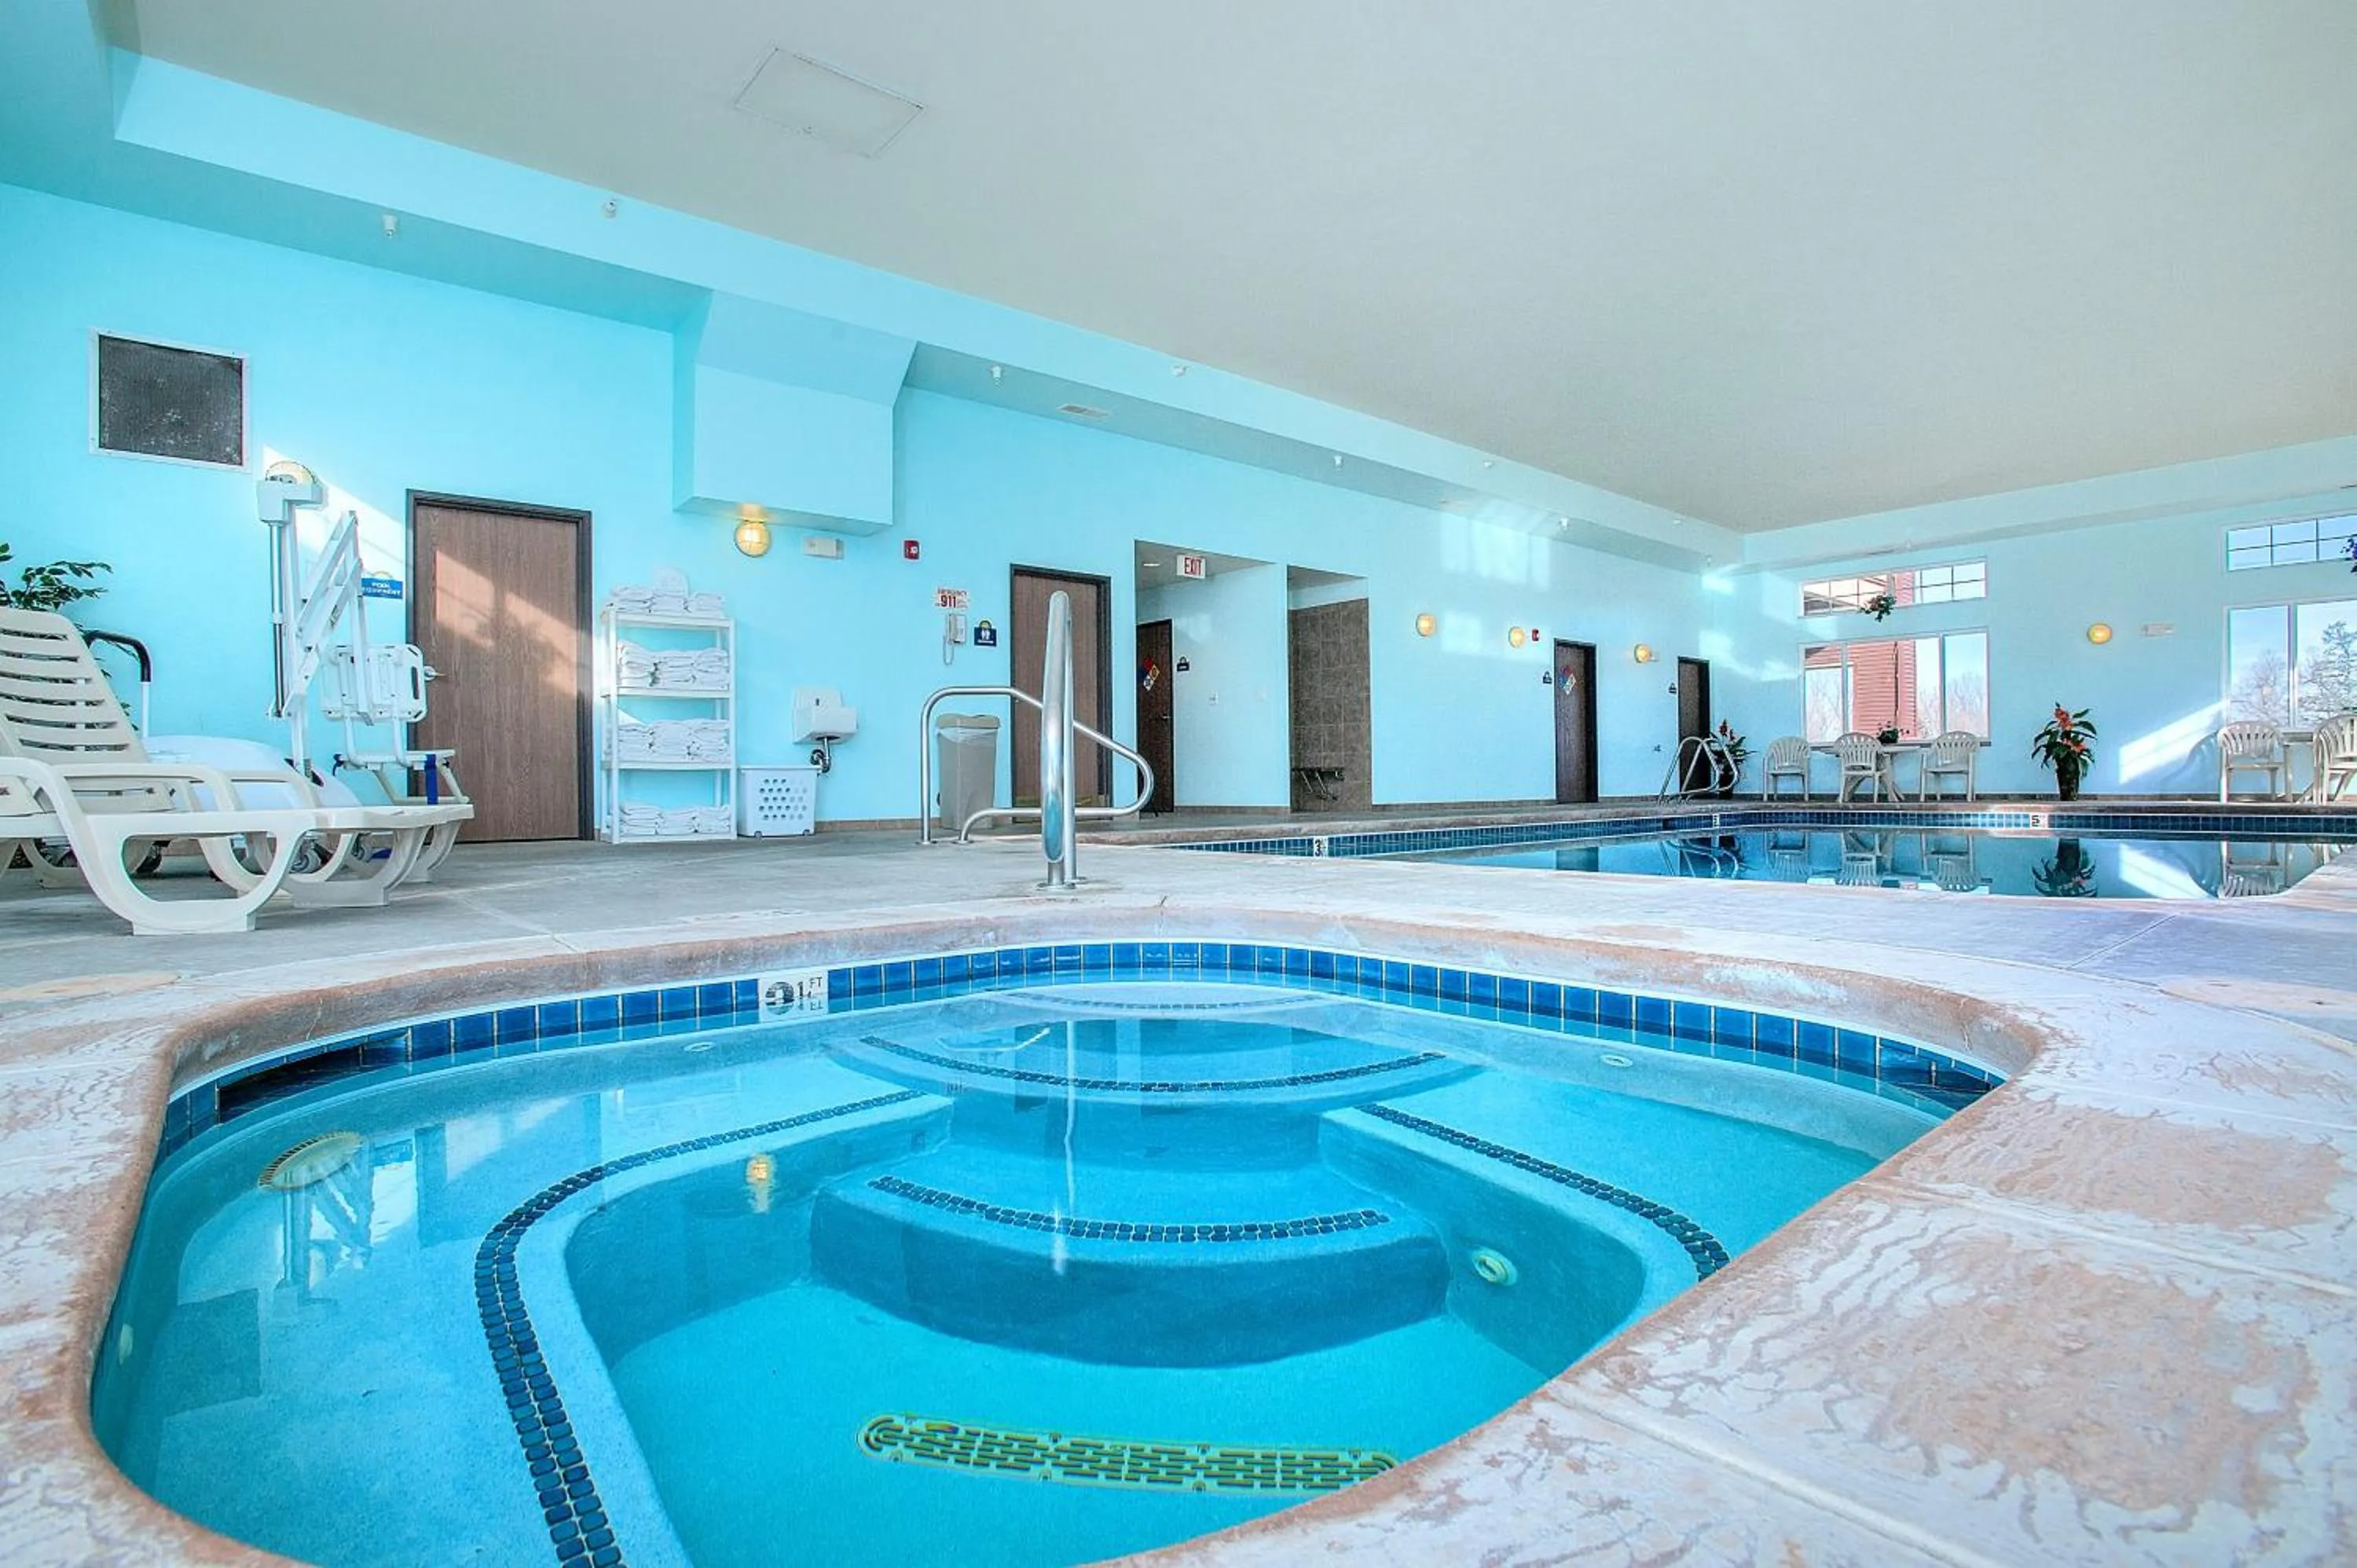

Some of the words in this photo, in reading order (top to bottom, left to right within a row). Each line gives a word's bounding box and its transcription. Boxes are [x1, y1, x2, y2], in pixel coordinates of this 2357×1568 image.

[1184, 556, 1202, 576] EXIT
[940, 595, 956, 608] 911
[808, 976, 823, 988] FT
